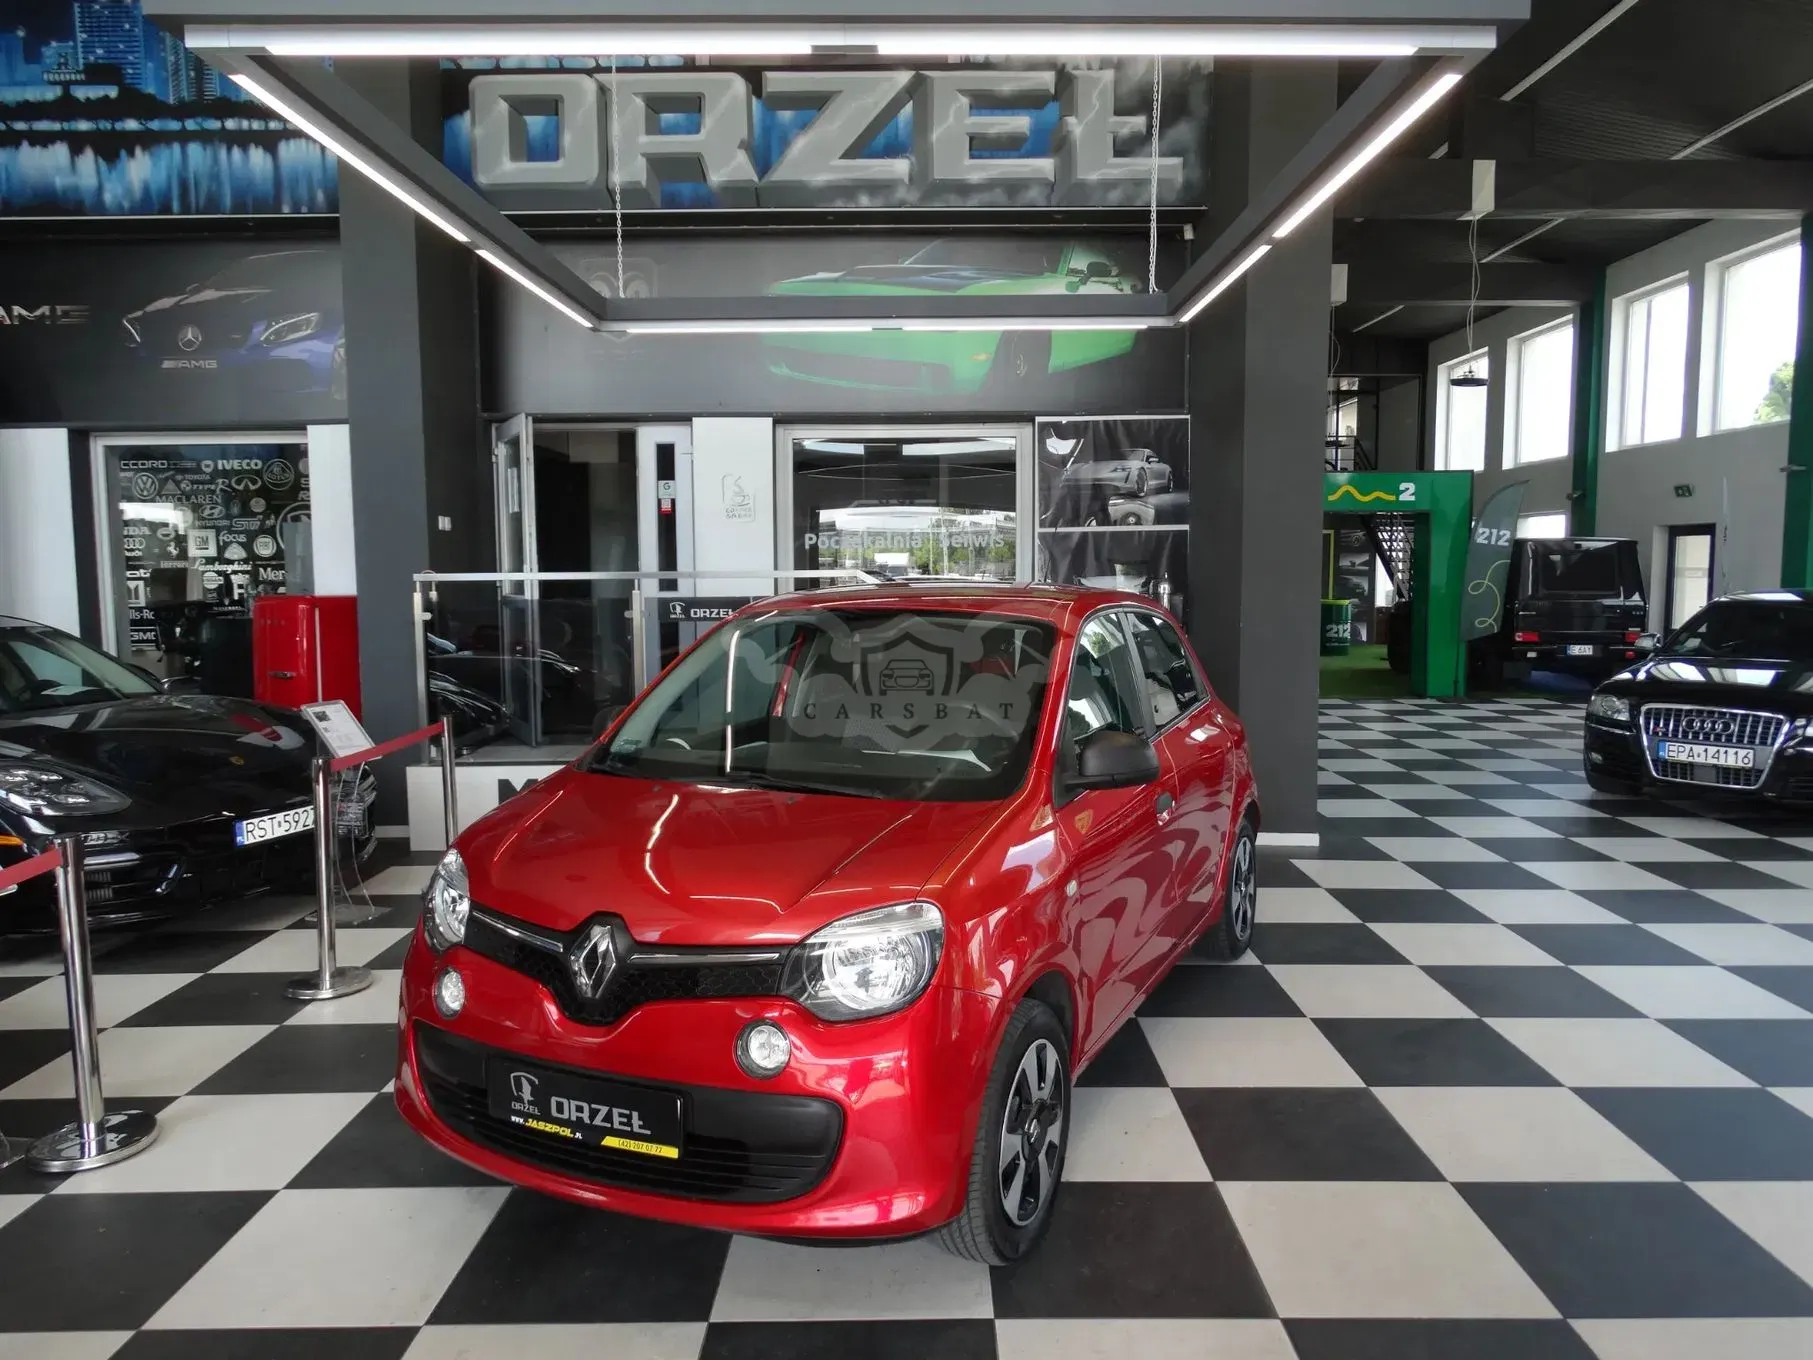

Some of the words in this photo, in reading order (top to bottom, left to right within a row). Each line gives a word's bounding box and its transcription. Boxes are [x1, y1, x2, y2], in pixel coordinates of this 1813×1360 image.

[467, 70, 1186, 192] ORZEŁ
[217, 460, 263, 470] IVECO
[1398, 482, 1416, 501] 2
[1476, 527, 1511, 546] 212
[191, 558, 253, 573] Lamborghini
[1667, 744, 1695, 760] EPA
[1703, 747, 1751, 765] 14116
[245, 816, 276, 842] RST
[511, 1101, 541, 1115] ORZEŁ
[551, 1096, 651, 1135] ORZEŁ
